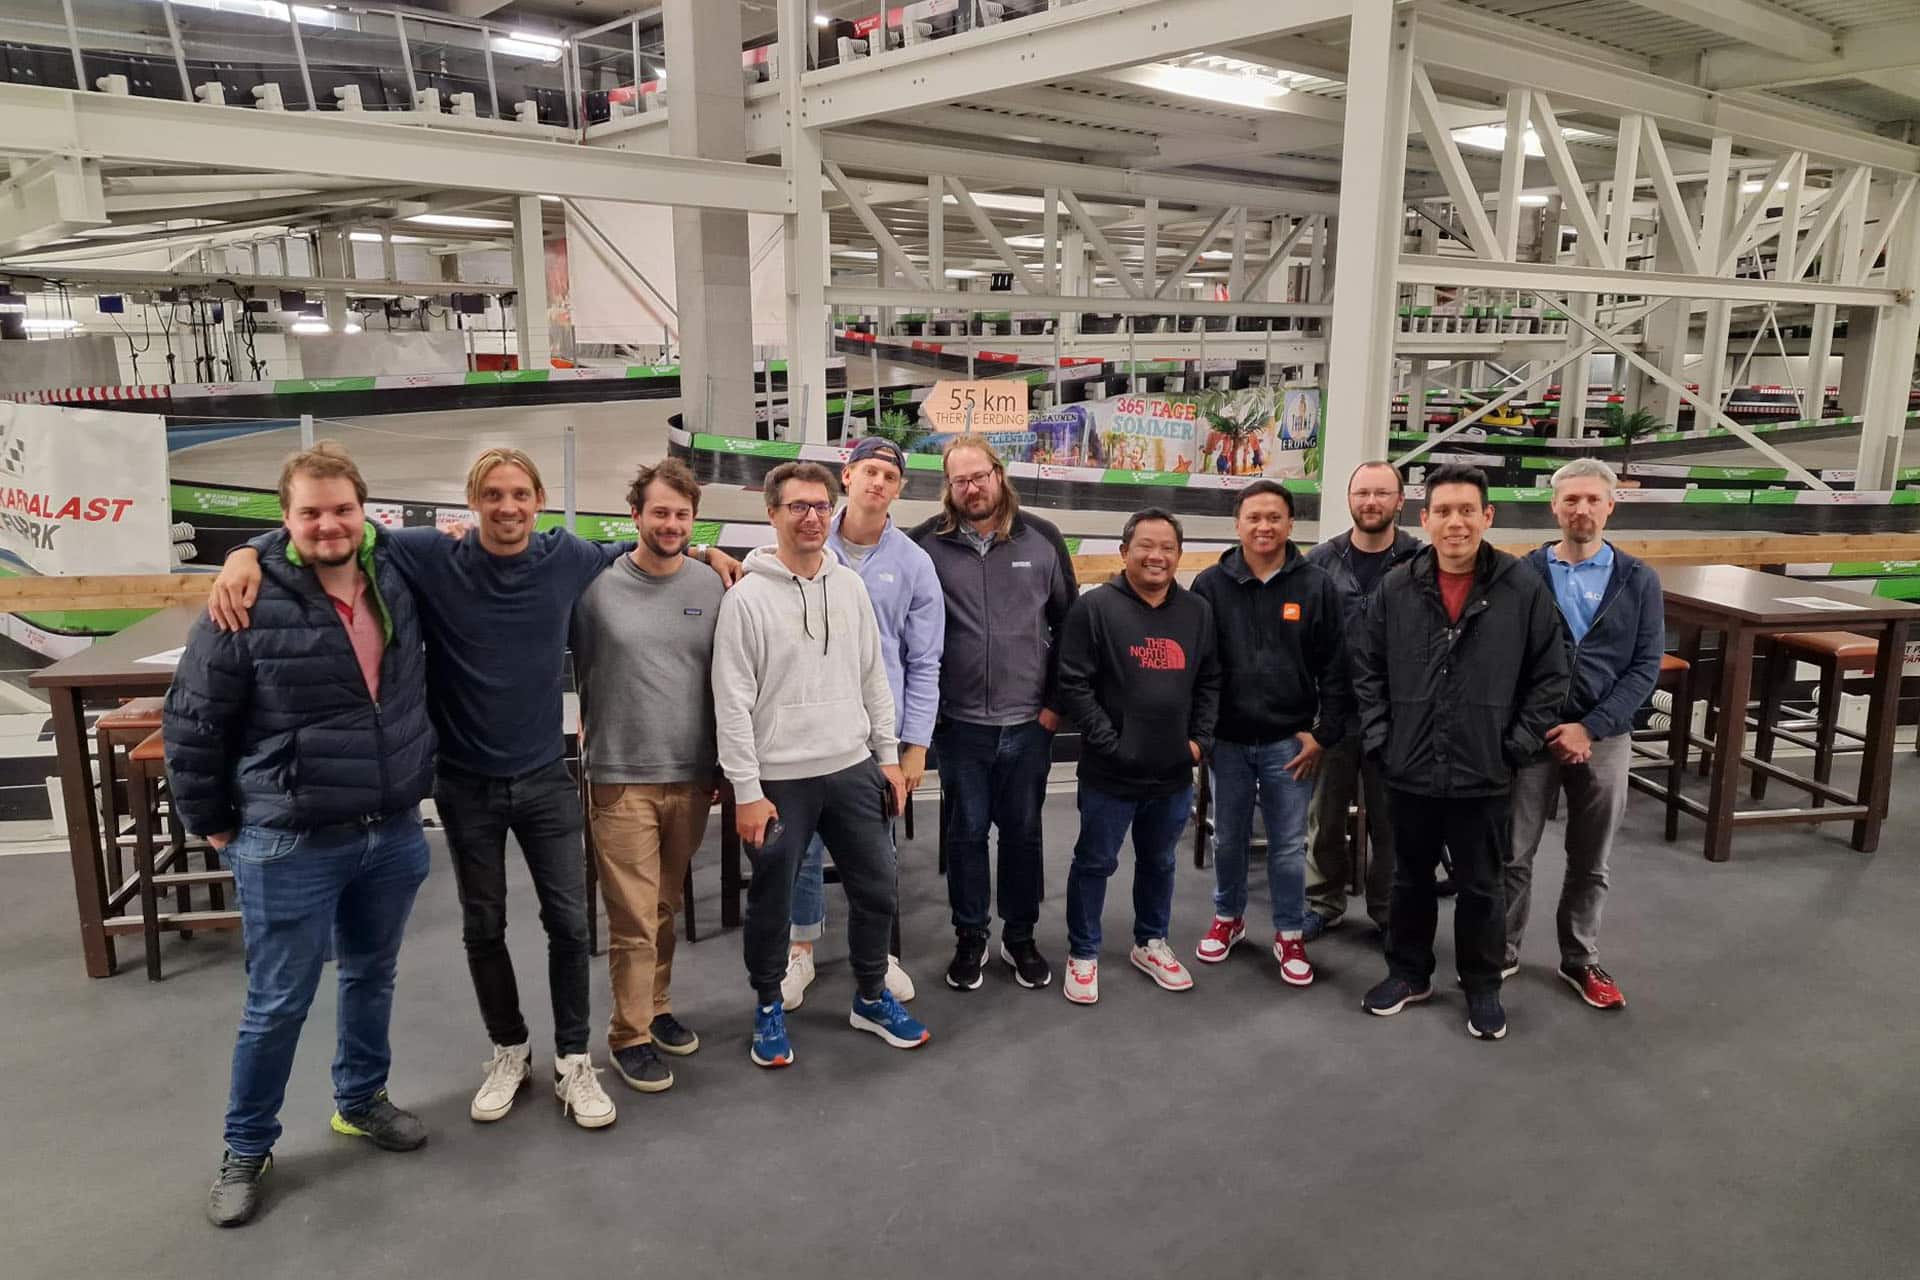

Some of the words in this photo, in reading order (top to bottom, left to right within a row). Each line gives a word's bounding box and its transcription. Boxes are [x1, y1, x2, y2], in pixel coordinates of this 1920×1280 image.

[951, 388, 975, 410] 55
[984, 388, 1016, 411] km
[1117, 398, 1145, 415] 365
[1151, 401, 1196, 420] TAGE
[983, 413, 1024, 424] ERDING
[1112, 416, 1193, 439] SOMMER
[1144, 637, 1166, 648] THE
[1130, 645, 1167, 659] NORTH
[1142, 657, 1168, 669] FACE
